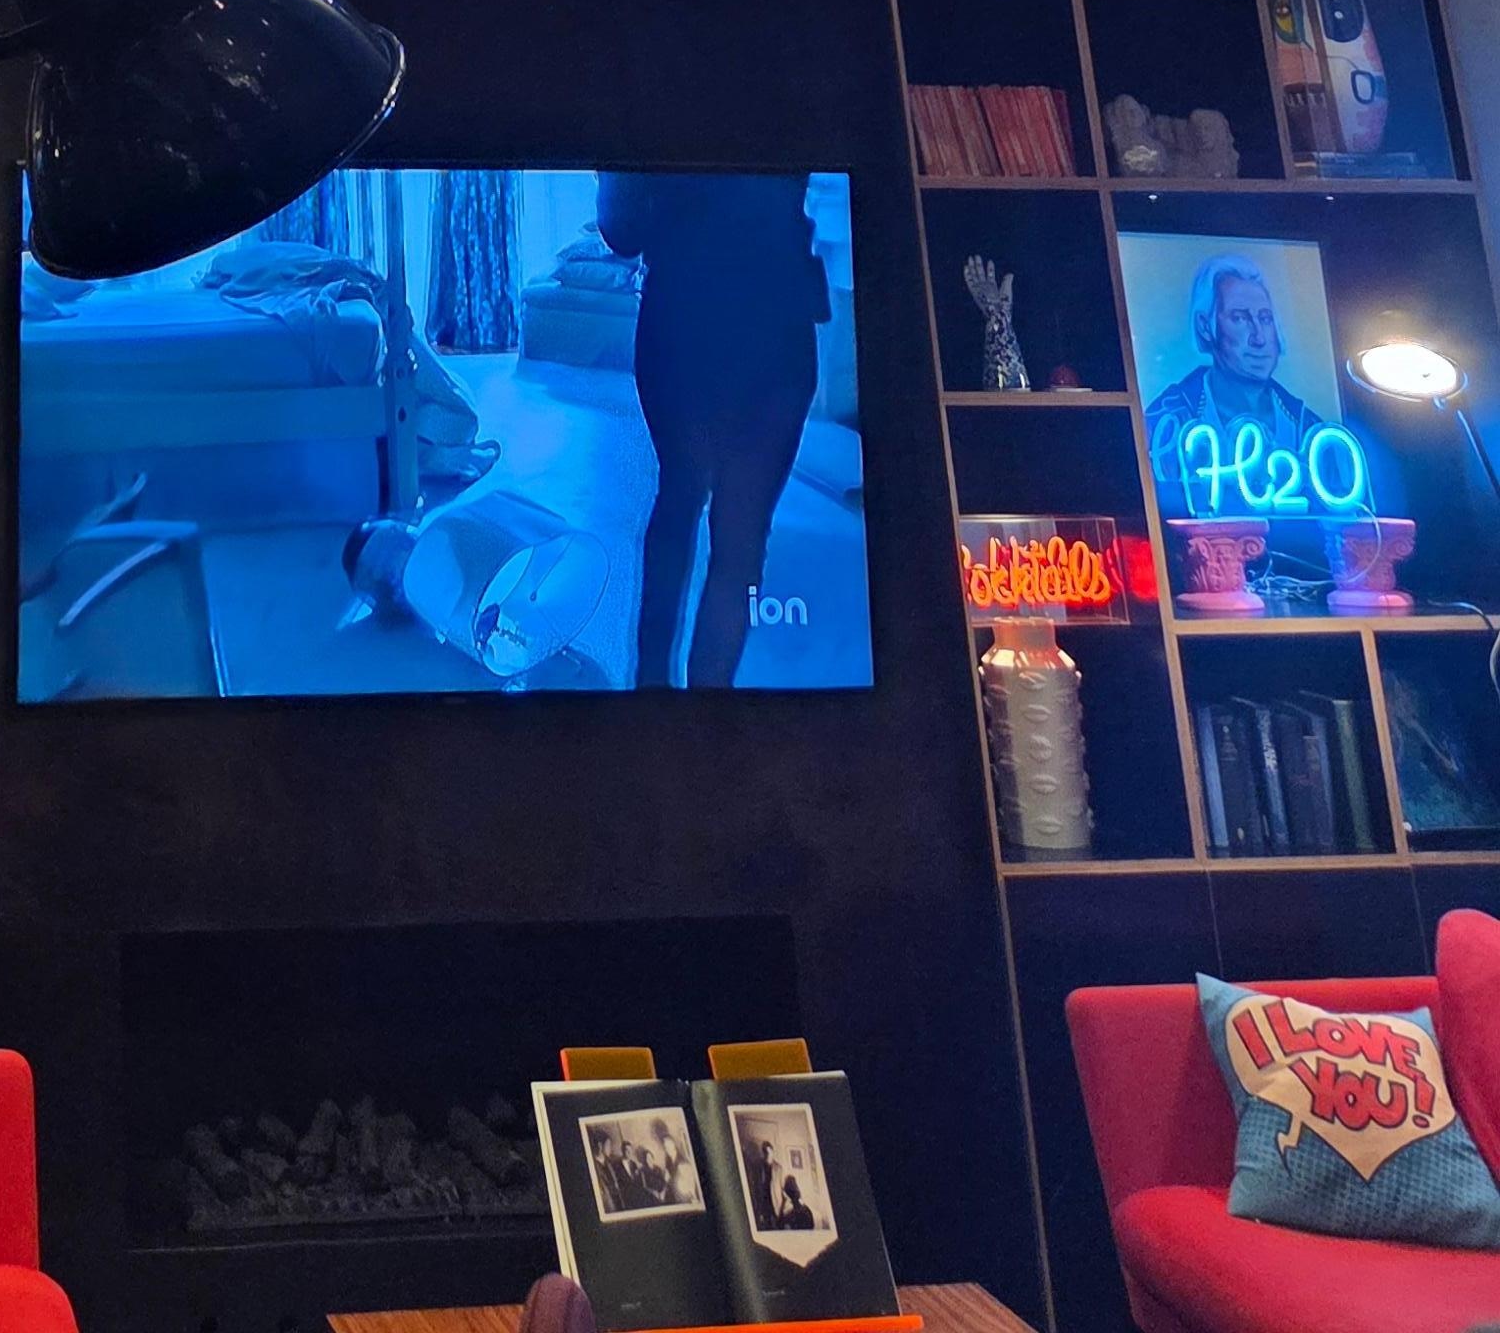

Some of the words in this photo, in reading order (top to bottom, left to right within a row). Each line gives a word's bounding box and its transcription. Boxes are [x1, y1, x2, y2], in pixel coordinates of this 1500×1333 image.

[1184, 423, 1365, 515] H2O
[748, 585, 808, 627] ion
[1232, 1009, 1275, 1070] I
[1262, 1001, 1422, 1082] LOVE
